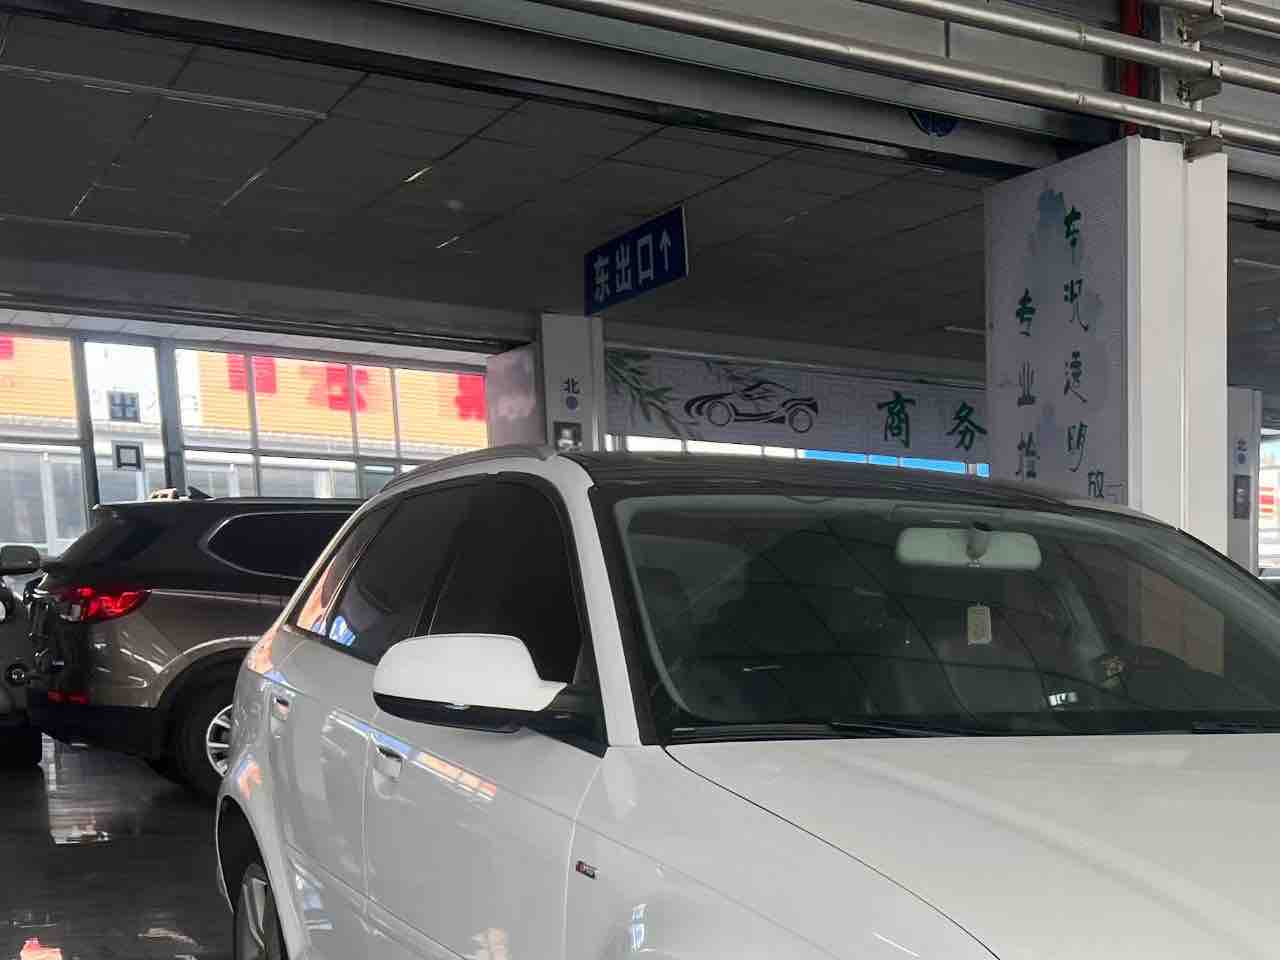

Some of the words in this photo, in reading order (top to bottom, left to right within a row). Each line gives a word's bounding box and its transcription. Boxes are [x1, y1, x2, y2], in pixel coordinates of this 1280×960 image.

[592, 232, 655, 303] 东出口
[876, 390, 988, 451] 商务
